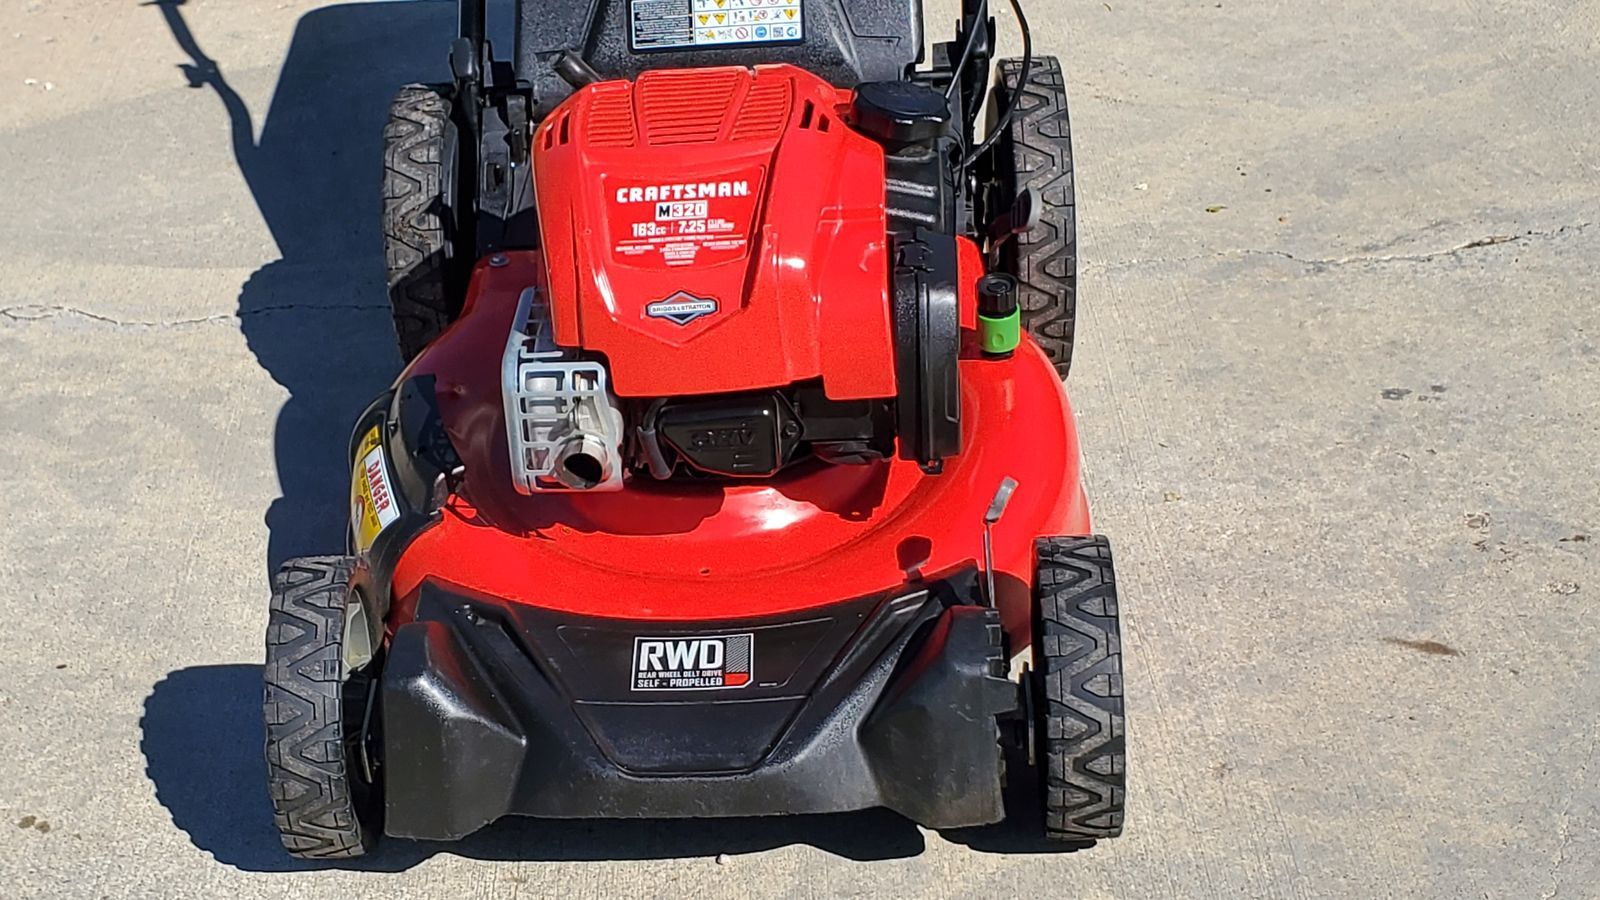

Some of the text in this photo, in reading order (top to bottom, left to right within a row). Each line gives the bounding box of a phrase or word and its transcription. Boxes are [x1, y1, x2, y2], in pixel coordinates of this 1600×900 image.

[616, 181, 748, 203] CRAFTSMAN
[658, 203, 705, 218] M320
[632, 222, 667, 237] 163cc
[678, 220, 706, 234] 7.25
[652, 305, 676, 313] BRIGGS
[681, 303, 711, 311] STRATTON
[366, 461, 389, 514] DANGER
[638, 640, 724, 671] RWD
[637, 669, 723, 679] REAR WHEEL BELT DRIVE
[637, 679, 660, 688] SELF
[670, 677, 723, 688] PROPELLED
